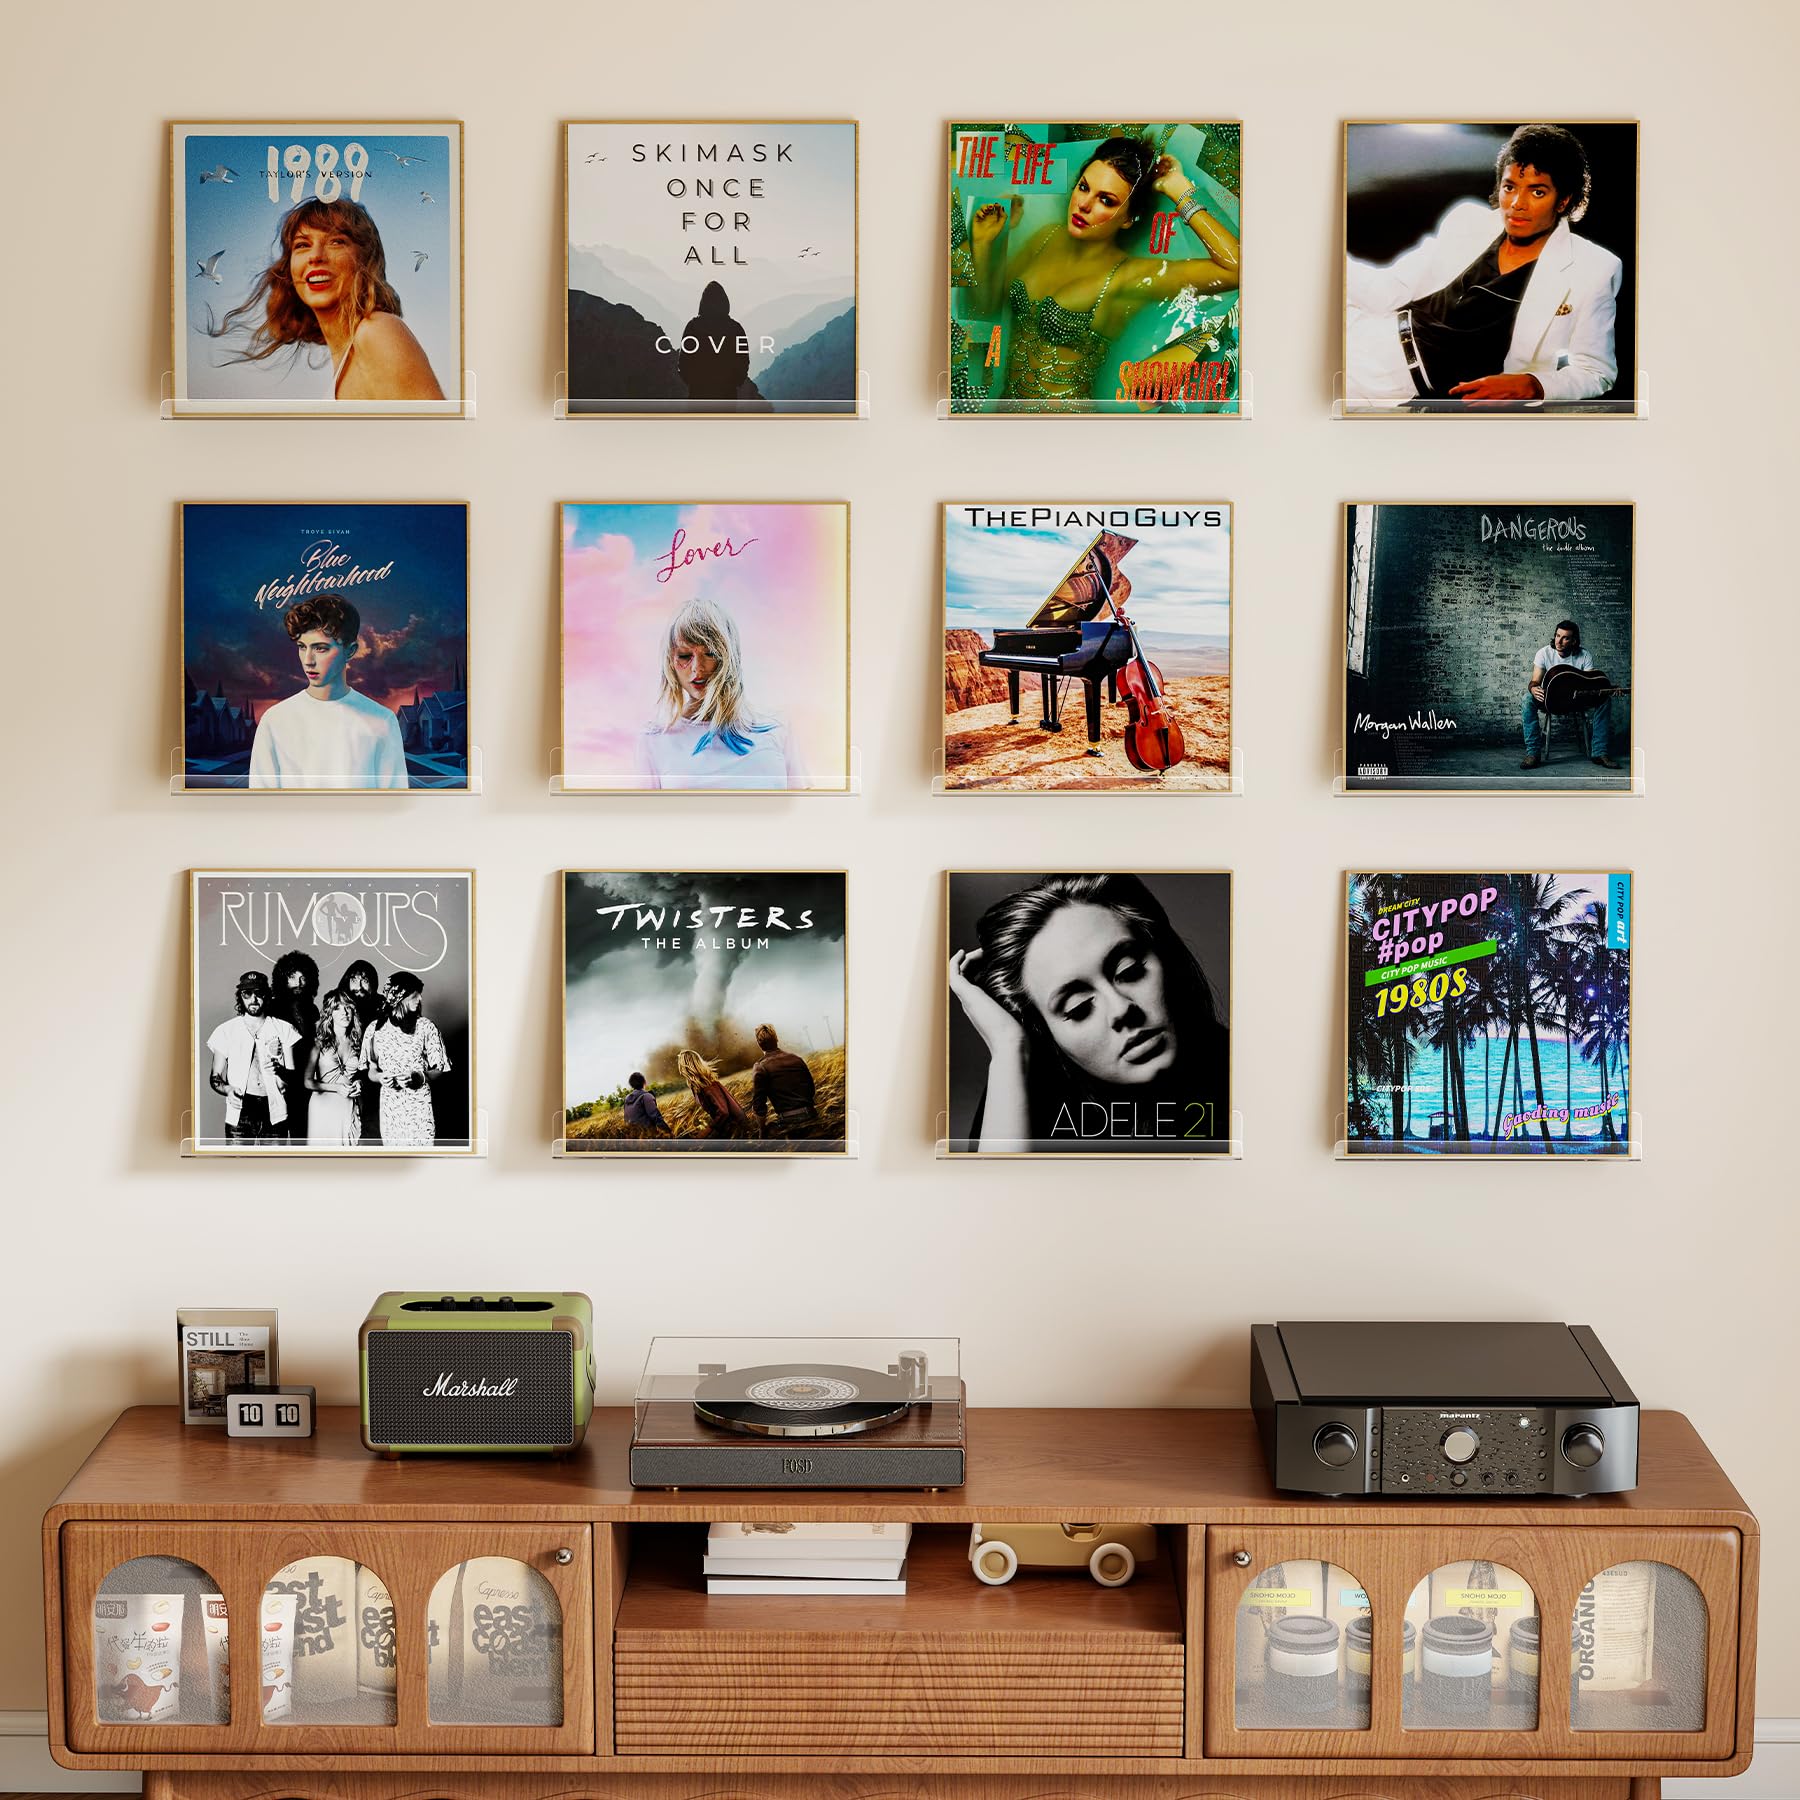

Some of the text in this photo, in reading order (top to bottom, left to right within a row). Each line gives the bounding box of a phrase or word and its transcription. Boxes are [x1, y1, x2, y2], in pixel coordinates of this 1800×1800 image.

[632, 143, 793, 162] SKIMASK
[958, 136, 1057, 184] THE LIFE
[259, 170, 373, 178] TAYLOR'S VERSION
[267, 142, 369, 204] 1989
[667, 178, 765, 198] ONCE
[682, 212, 750, 231] FOR
[1149, 211, 1179, 254] OF
[684, 246, 748, 265] ALL
[655, 335, 775, 353] COVER
[984, 325, 1001, 367] A
[1116, 361, 1232, 403] SHOWGIRL
[1481, 513, 1587, 543] DANGEROUS
[300, 539, 352, 573] Blue
[653, 528, 759, 583] Lover
[1542, 543, 1553, 551] the
[254, 561, 394, 609] Neighbourhood
[1353, 709, 1457, 739] Morgan Wallen
[596, 903, 814, 930] TWISTERS
[1372, 887, 1497, 941] CITYPOP
[1378, 897, 1420, 915] DREAM CITY
[218, 890, 448, 972] RUMOURS
[642, 938, 769, 949] THE ALBUM
[1616, 920, 1627, 944] art
[1377, 932, 1444, 964] #pop
[1381, 956, 1448, 980] CITY POP MUSIC
[1051, 1102, 1214, 1137] ADELE 21
[1503, 1092, 1619, 1139] Gaoding music
[187, 1332, 235, 1346] STILL
[422, 1372, 519, 1397] Marshall
[240, 1405, 298, 1423] 10 10
[478, 1581, 520, 1600] Capresso
[473, 1604, 542, 1632] eas
